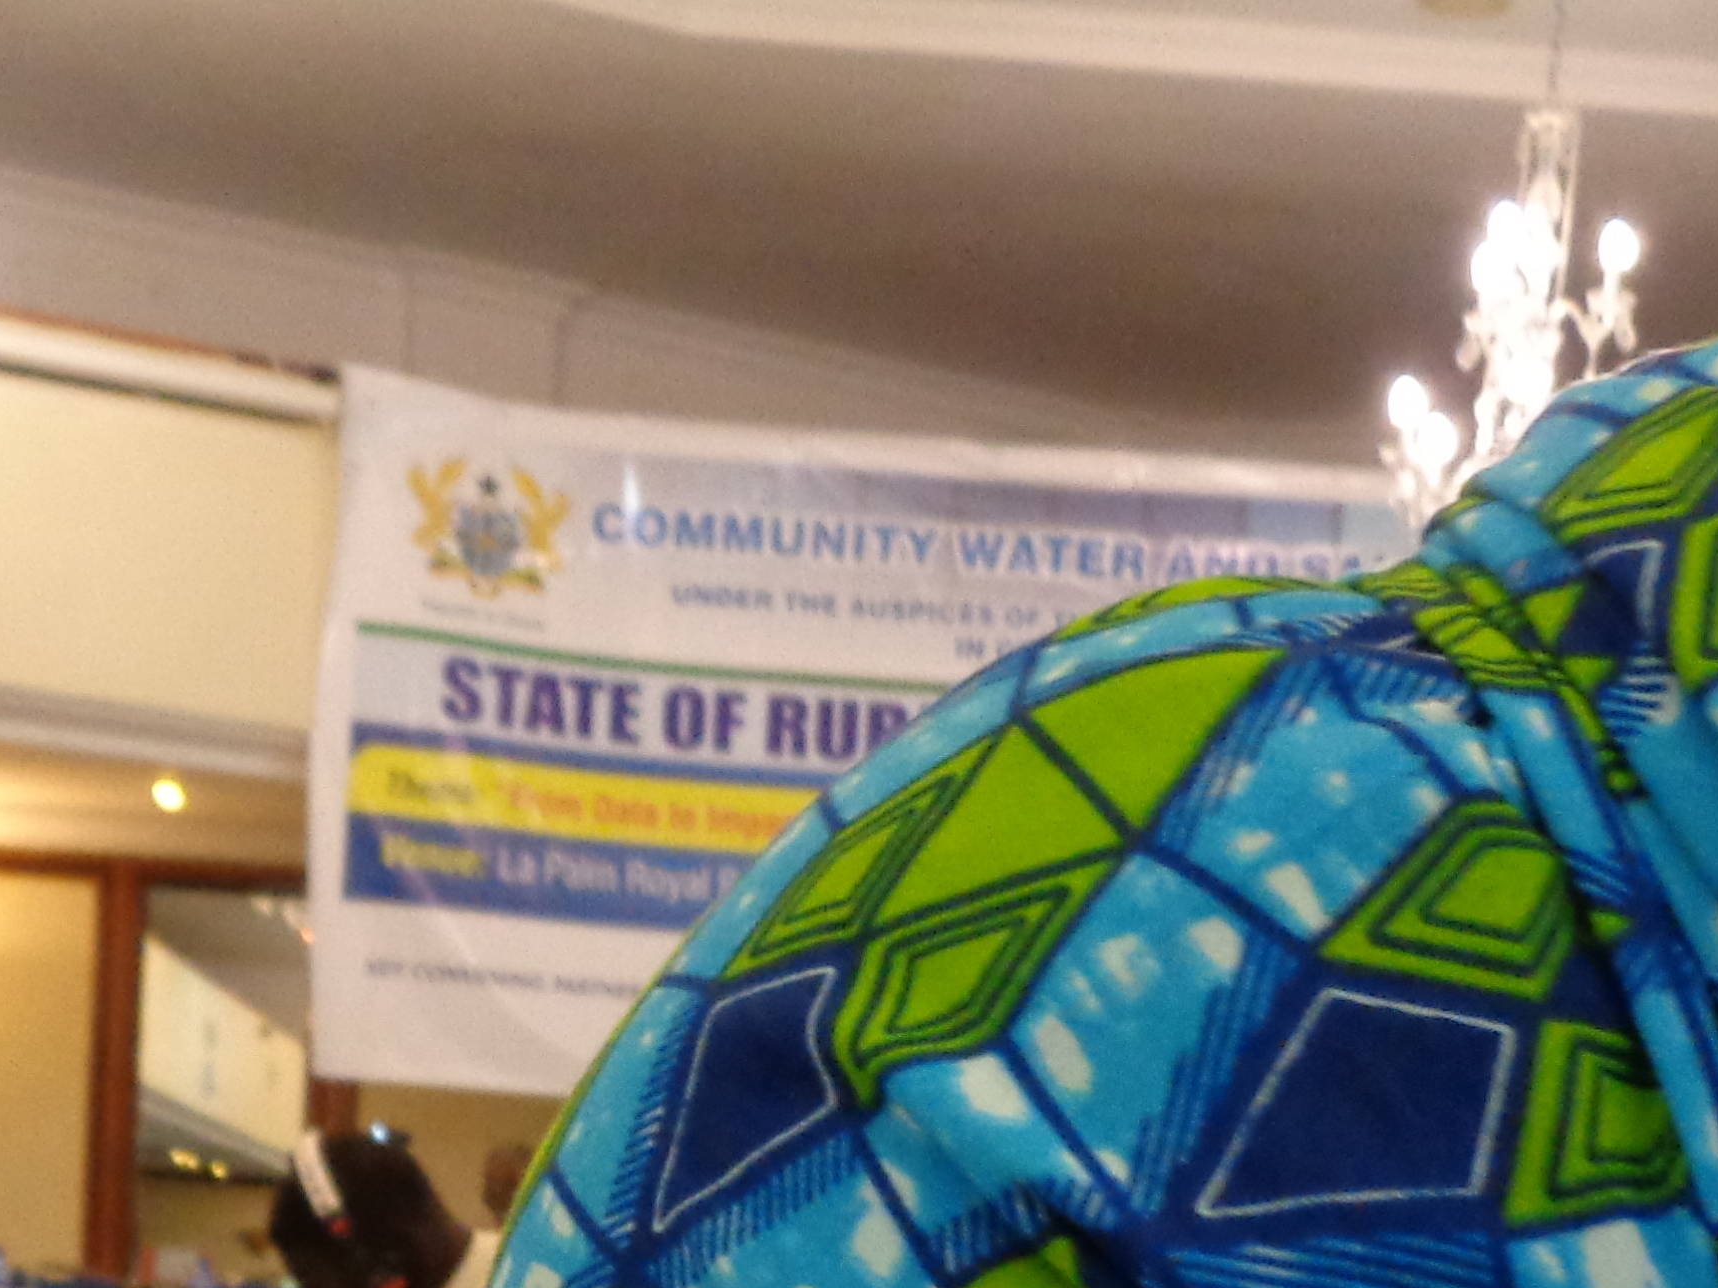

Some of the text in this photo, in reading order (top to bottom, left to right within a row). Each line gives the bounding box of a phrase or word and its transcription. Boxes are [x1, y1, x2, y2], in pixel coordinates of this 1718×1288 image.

[593, 502, 936, 563] COMMUNITY
[960, 533, 1145, 579] WATER
[671, 583, 772, 612] UNDER
[785, 591, 837, 616] THE
[441, 655, 641, 747] STATE
[662, 686, 746, 752] OF
[495, 848, 537, 886] La
[545, 850, 619, 893] Palm
[625, 855, 711, 902] Royal
